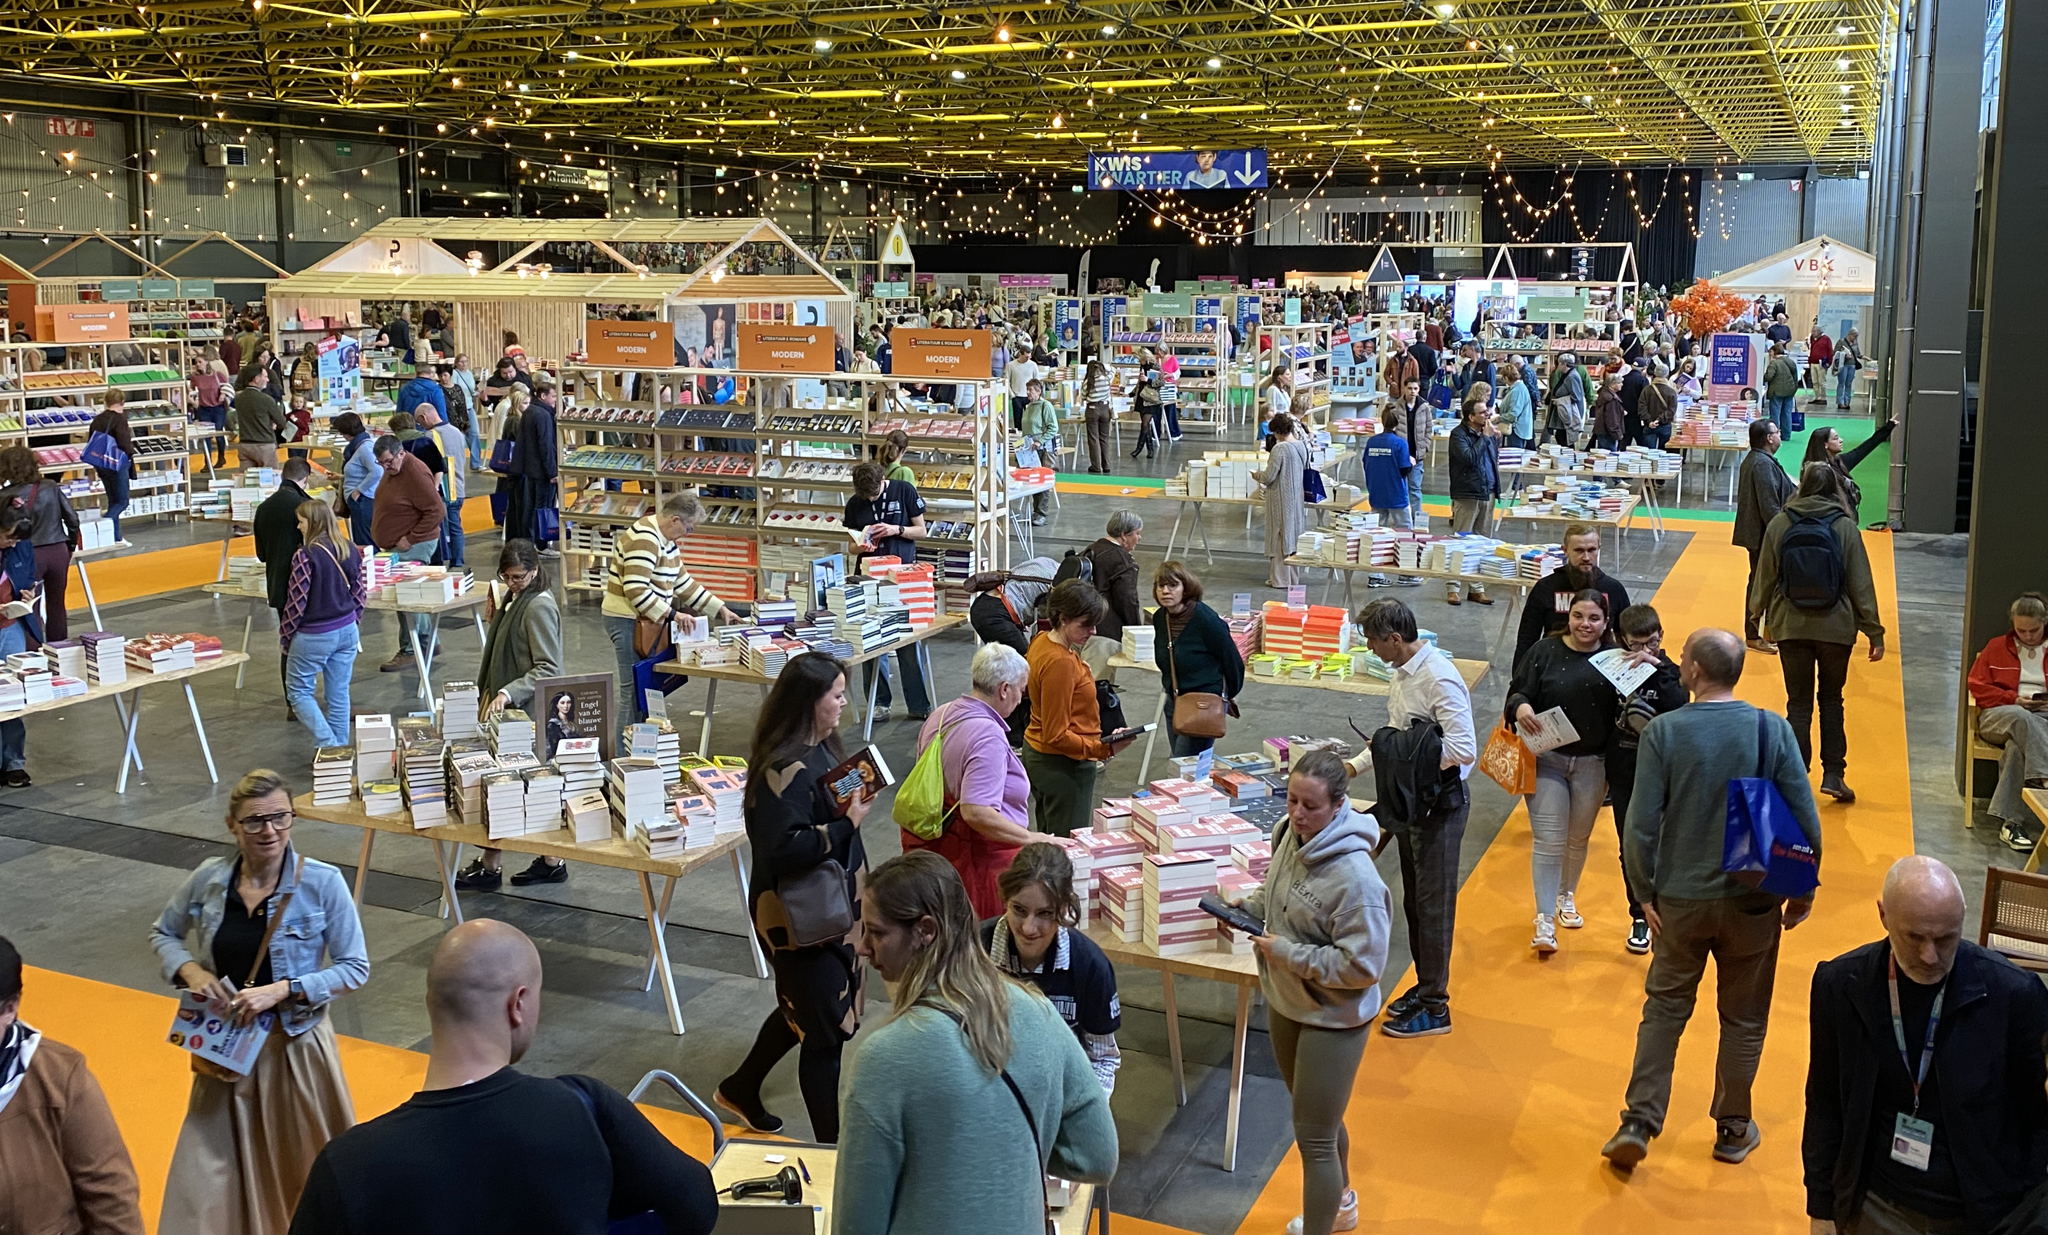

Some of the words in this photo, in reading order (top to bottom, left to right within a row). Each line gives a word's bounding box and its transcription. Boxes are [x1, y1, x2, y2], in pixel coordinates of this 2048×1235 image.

[1094, 156, 1142, 171] KWIS
[1094, 170, 1182, 185] KWARTIER
[617, 345, 647, 354] MODERN
[771, 350, 805, 359] MODERN
[925, 355, 960, 364] MODERN
[580, 700, 599, 709] Engel
